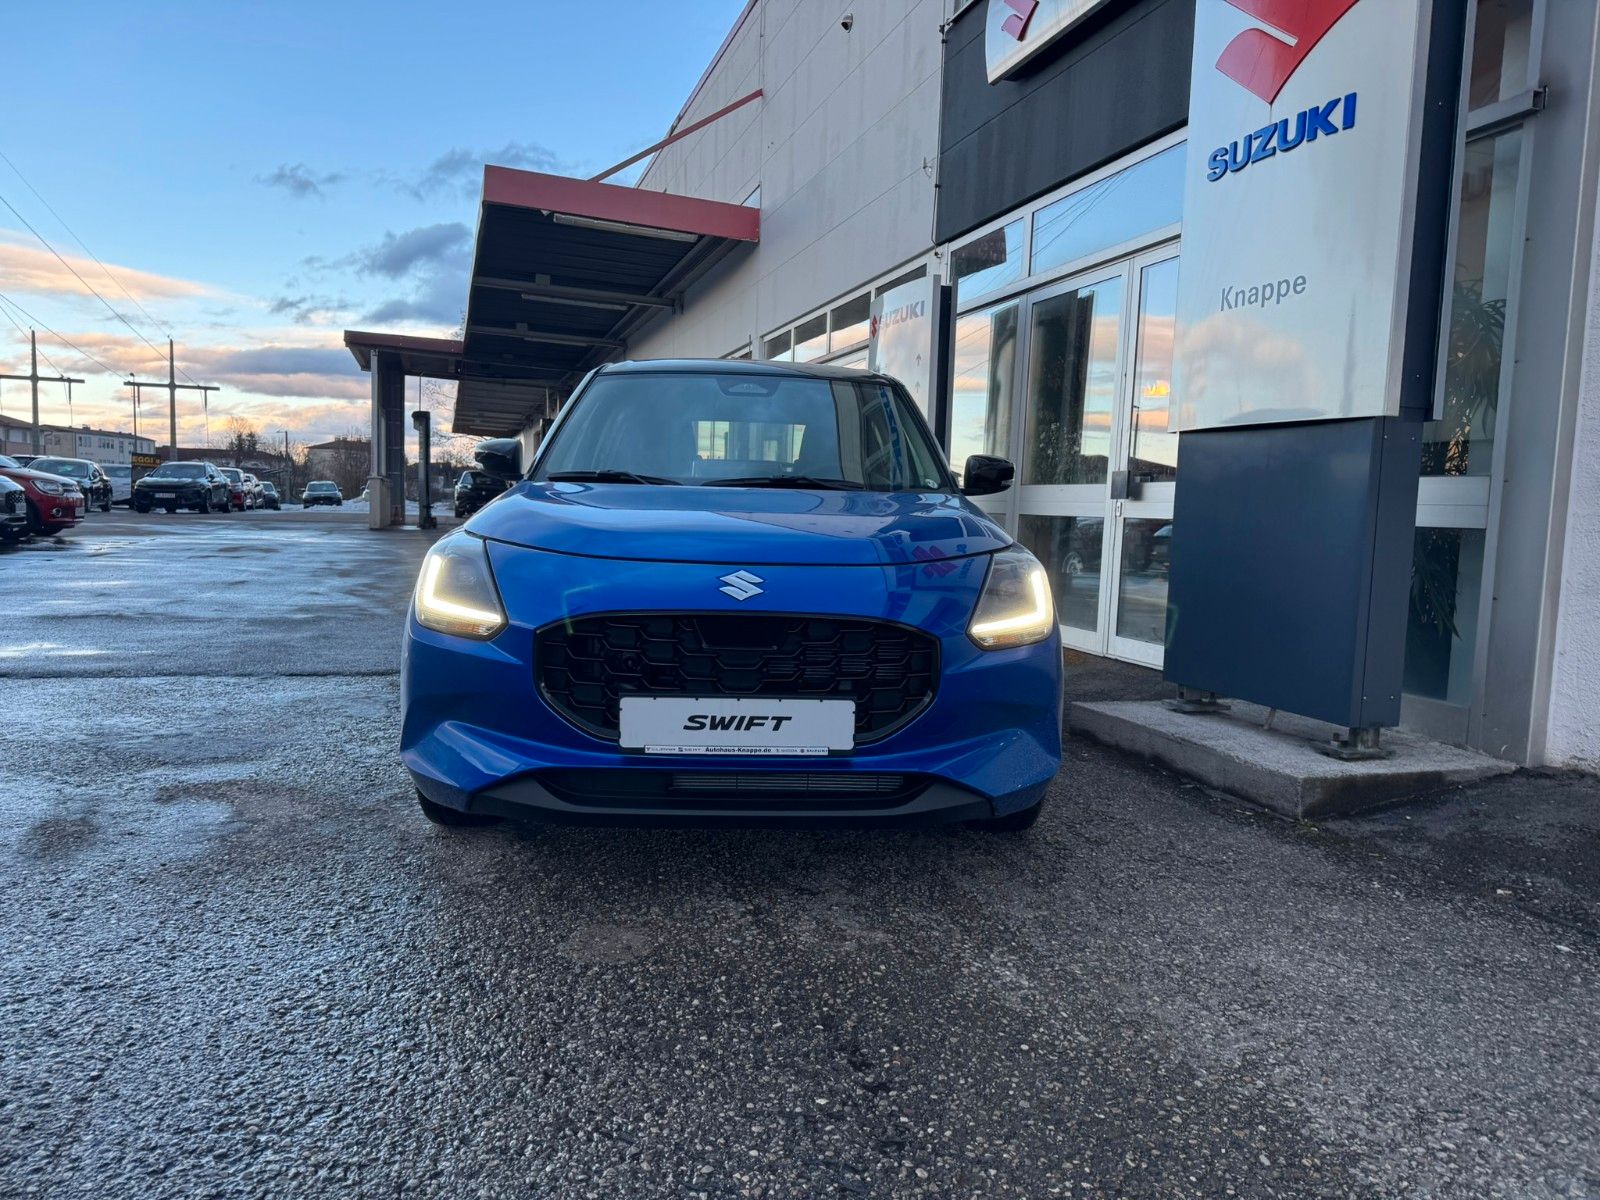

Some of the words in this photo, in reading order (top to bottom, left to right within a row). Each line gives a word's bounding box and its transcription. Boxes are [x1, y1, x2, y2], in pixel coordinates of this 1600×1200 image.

[1206, 92, 1357, 182] SUZUKI
[1220, 275, 1307, 311] Knappe
[683, 714, 792, 731] SWIFT
